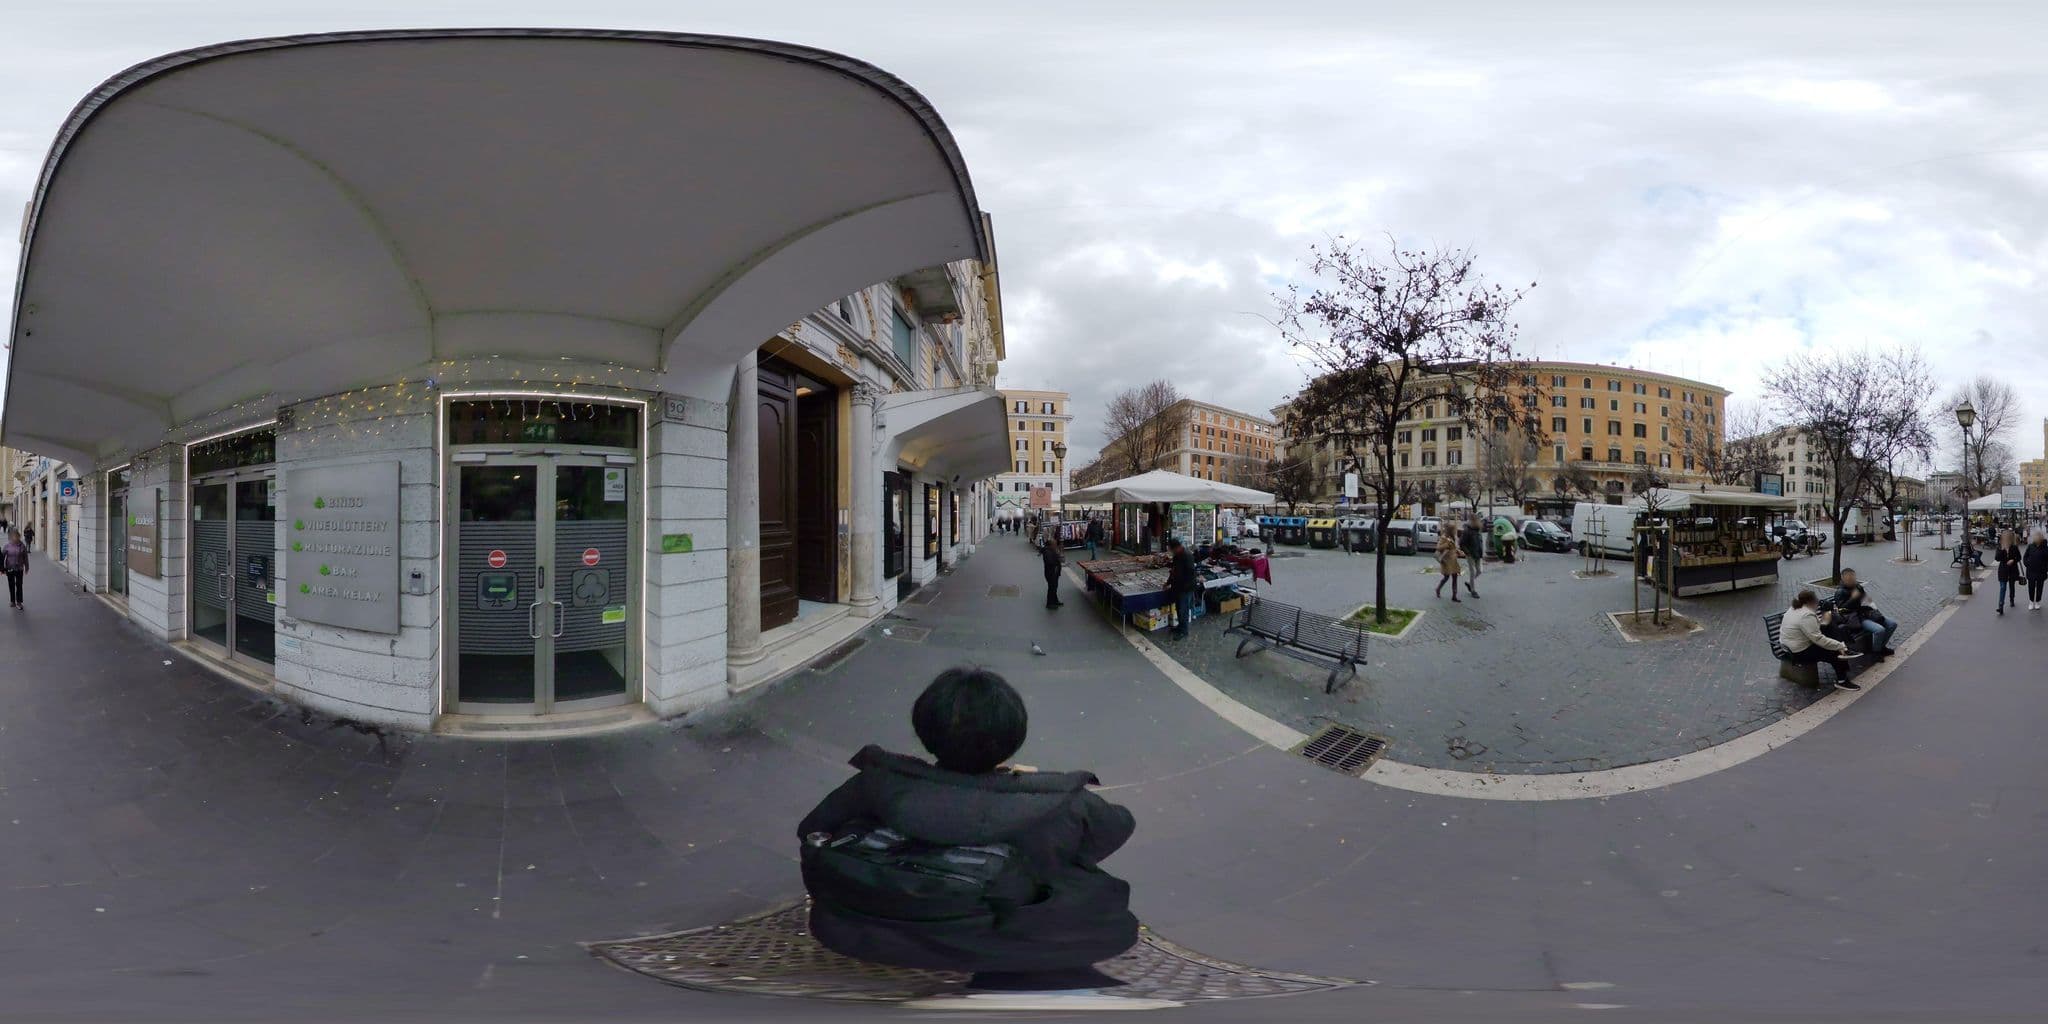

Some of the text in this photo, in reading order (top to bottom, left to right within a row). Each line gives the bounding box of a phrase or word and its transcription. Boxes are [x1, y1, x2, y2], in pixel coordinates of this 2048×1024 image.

[670, 402, 685, 413] 90
[327, 496, 364, 508] BINGO
[305, 520, 388, 532] VIDEOLOTTERY
[304, 543, 393, 556] RISTORAZIONE
[332, 567, 359, 578] BAR
[311, 583, 382, 602] AREA RELAX
